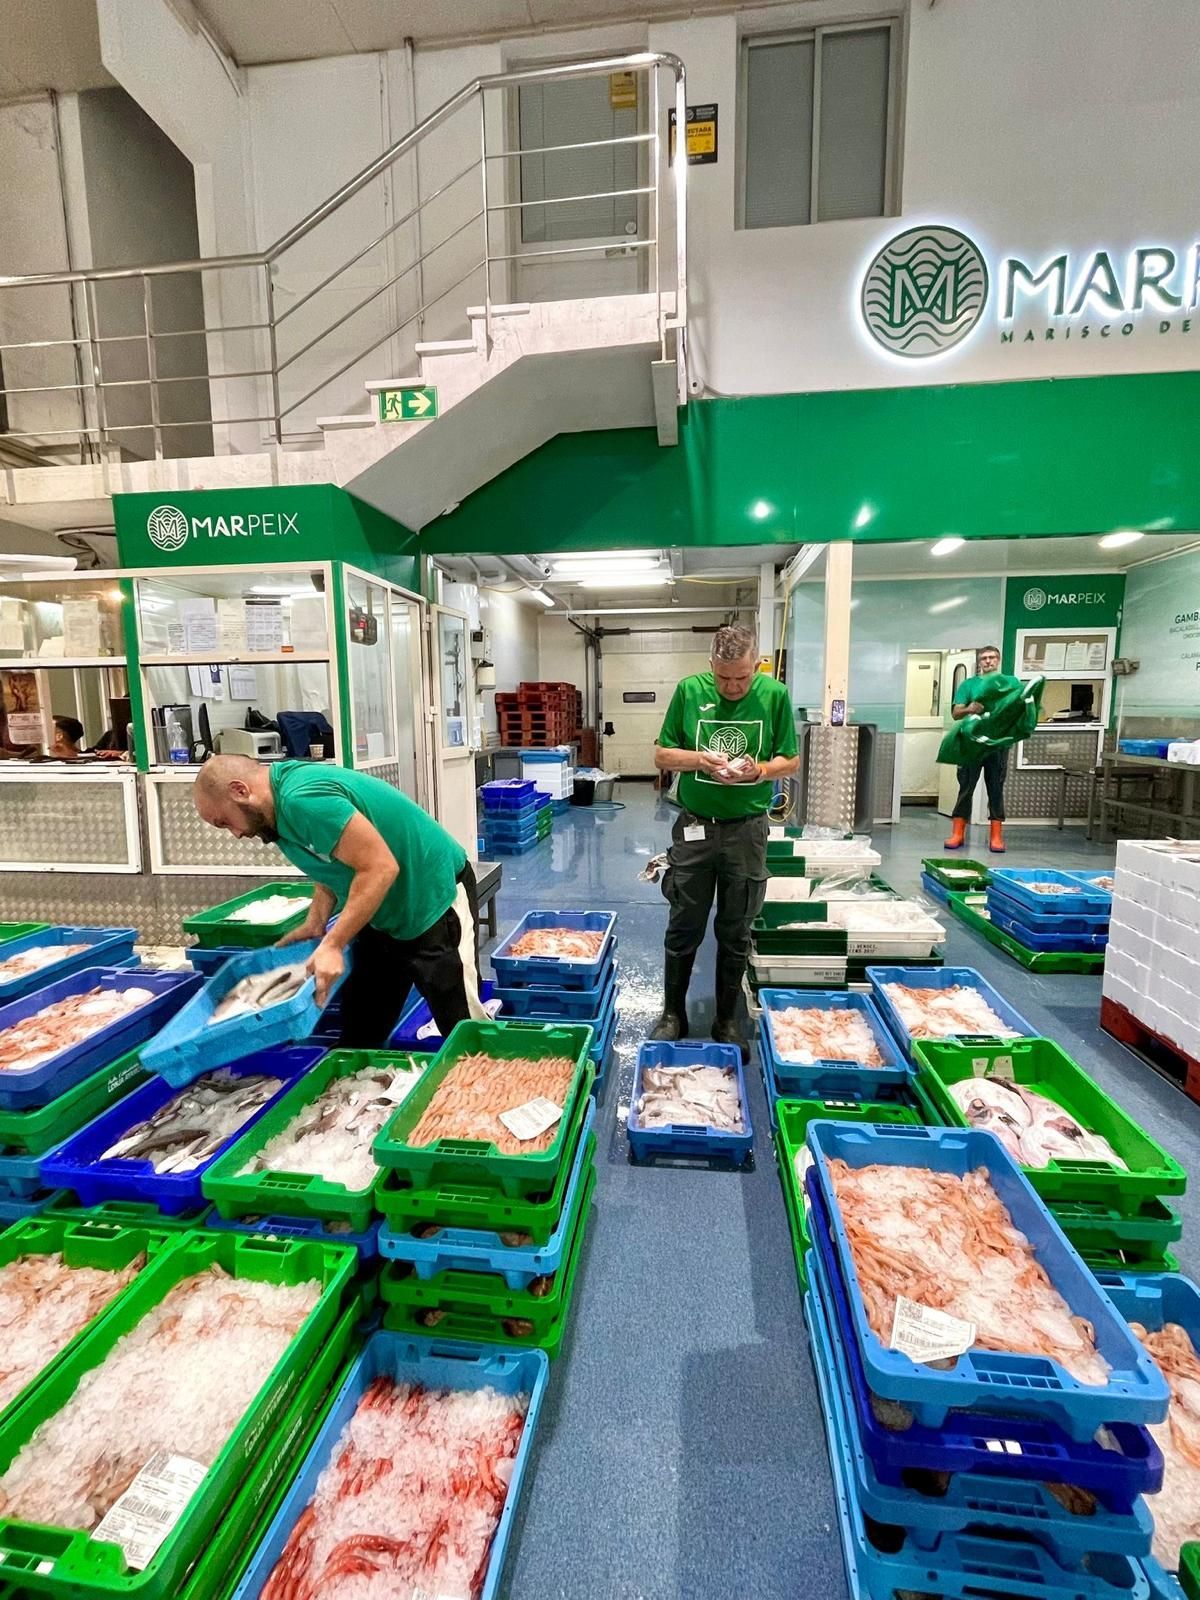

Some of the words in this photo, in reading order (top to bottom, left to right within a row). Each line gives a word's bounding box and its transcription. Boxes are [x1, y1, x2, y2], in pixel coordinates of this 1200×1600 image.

[1003, 244, 1200, 319] MAR
[1001, 322, 1134, 344] MARISCO
[1159, 319, 1192, 334] DE
[191, 512, 300, 539] MARPEIX
[1047, 592, 1106, 605] MARPEIX
[1174, 611, 1200, 624] GAMB
